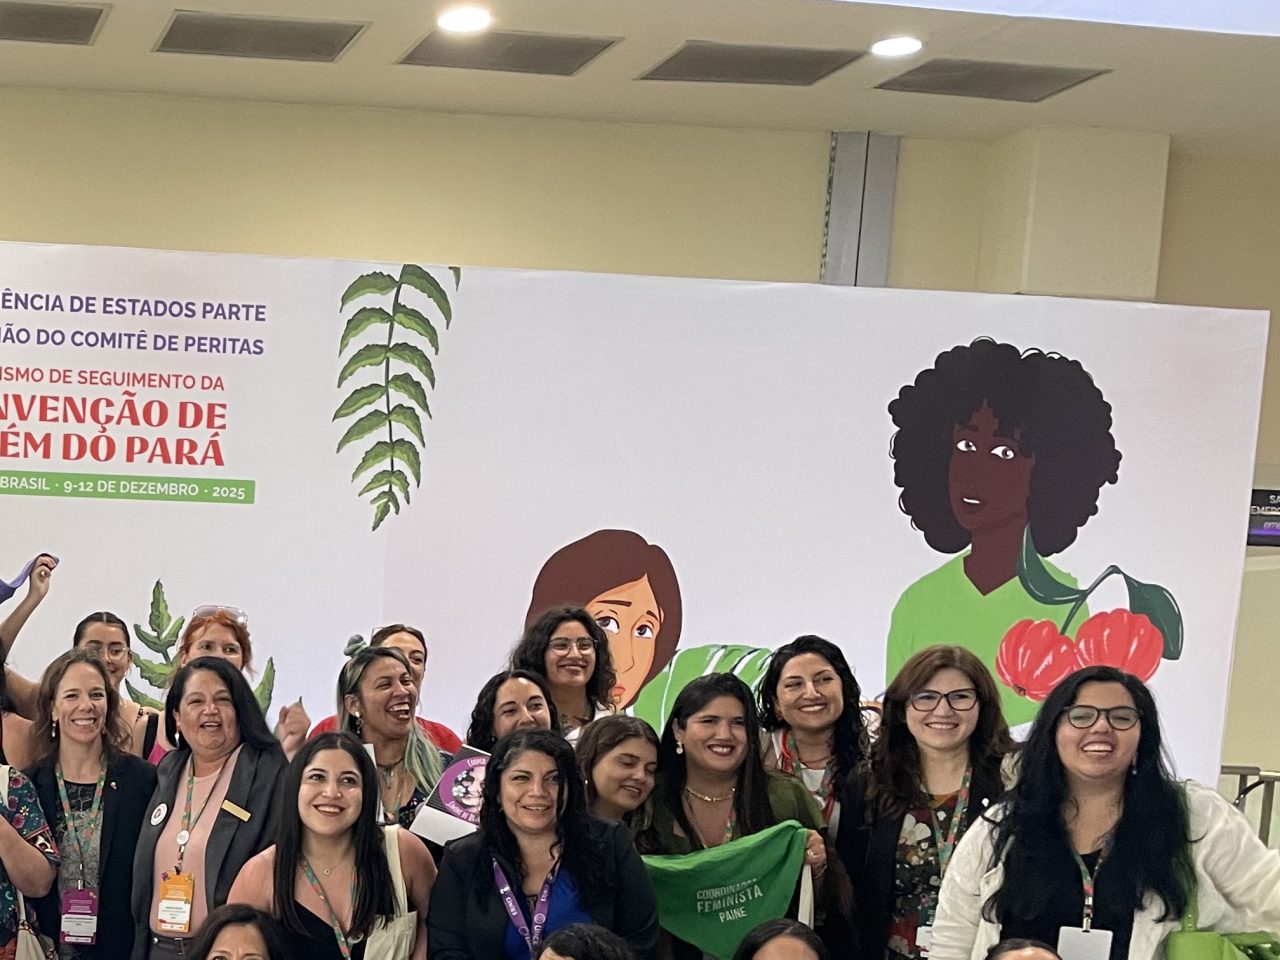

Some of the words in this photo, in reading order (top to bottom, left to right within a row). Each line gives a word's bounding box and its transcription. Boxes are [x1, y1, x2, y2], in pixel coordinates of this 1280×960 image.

[69, 295, 97, 314] DE
[102, 297, 197, 319] ESTADOS
[201, 302, 267, 322] PARTE
[36, 328, 66, 346] DO
[70, 329, 148, 351] COMITÊ
[152, 334, 179, 352] DE
[184, 335, 264, 356] PERITAS
[49, 368, 73, 385] DE
[77, 369, 196, 391] SEGUIMENTO
[200, 375, 225, 391] DA
[178, 401, 228, 430] DE
[62, 433, 116, 462] DO
[125, 431, 226, 467] PARÁ
[0, 476, 51, 491] BRASIL
[63, 480, 94, 494] 9-12
[97, 480, 117, 494] DE
[120, 481, 199, 497] DEZEMBRO
[211, 486, 246, 500] 2025
[696, 885, 763, 913] FEMINISTA
[718, 906, 748, 923] PAINE
